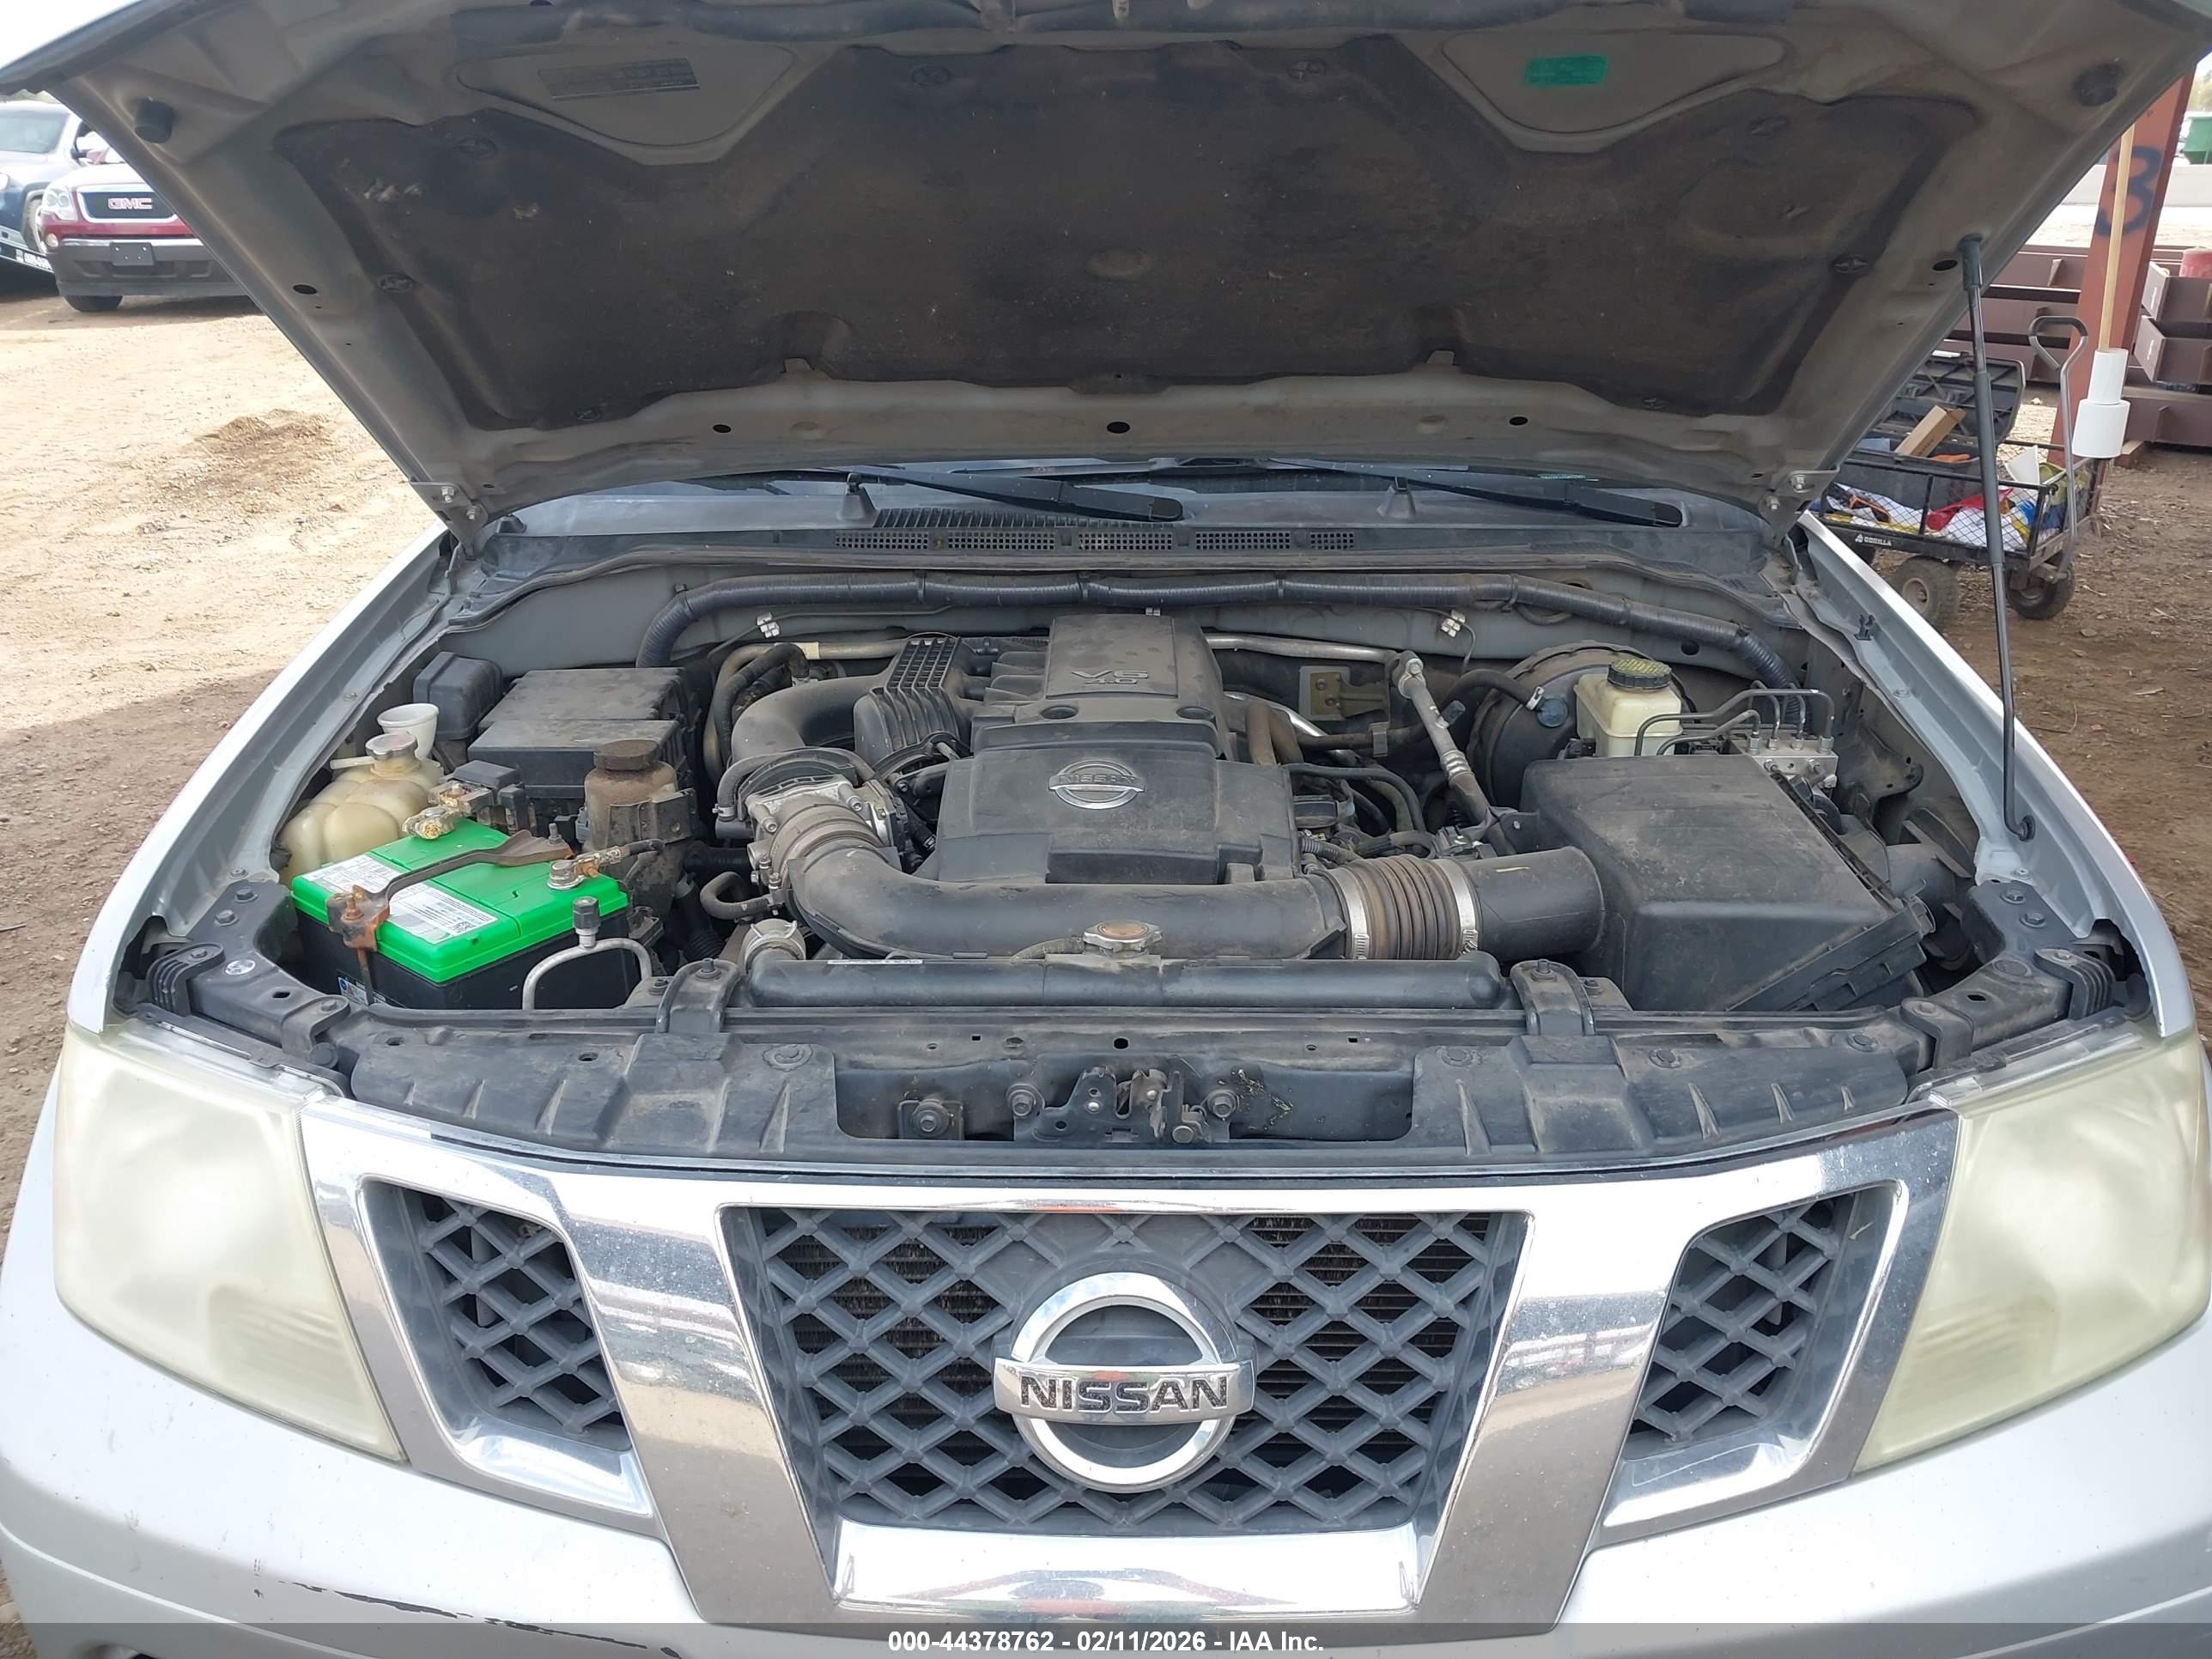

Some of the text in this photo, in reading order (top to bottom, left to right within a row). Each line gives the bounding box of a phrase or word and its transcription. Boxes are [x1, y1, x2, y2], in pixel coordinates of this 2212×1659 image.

[108, 198, 152, 210] GMC
[1071, 670, 1148, 679] V6
[1059, 774, 1137, 784] NISSAN
[1020, 1376, 1228, 1413] NISSAN
